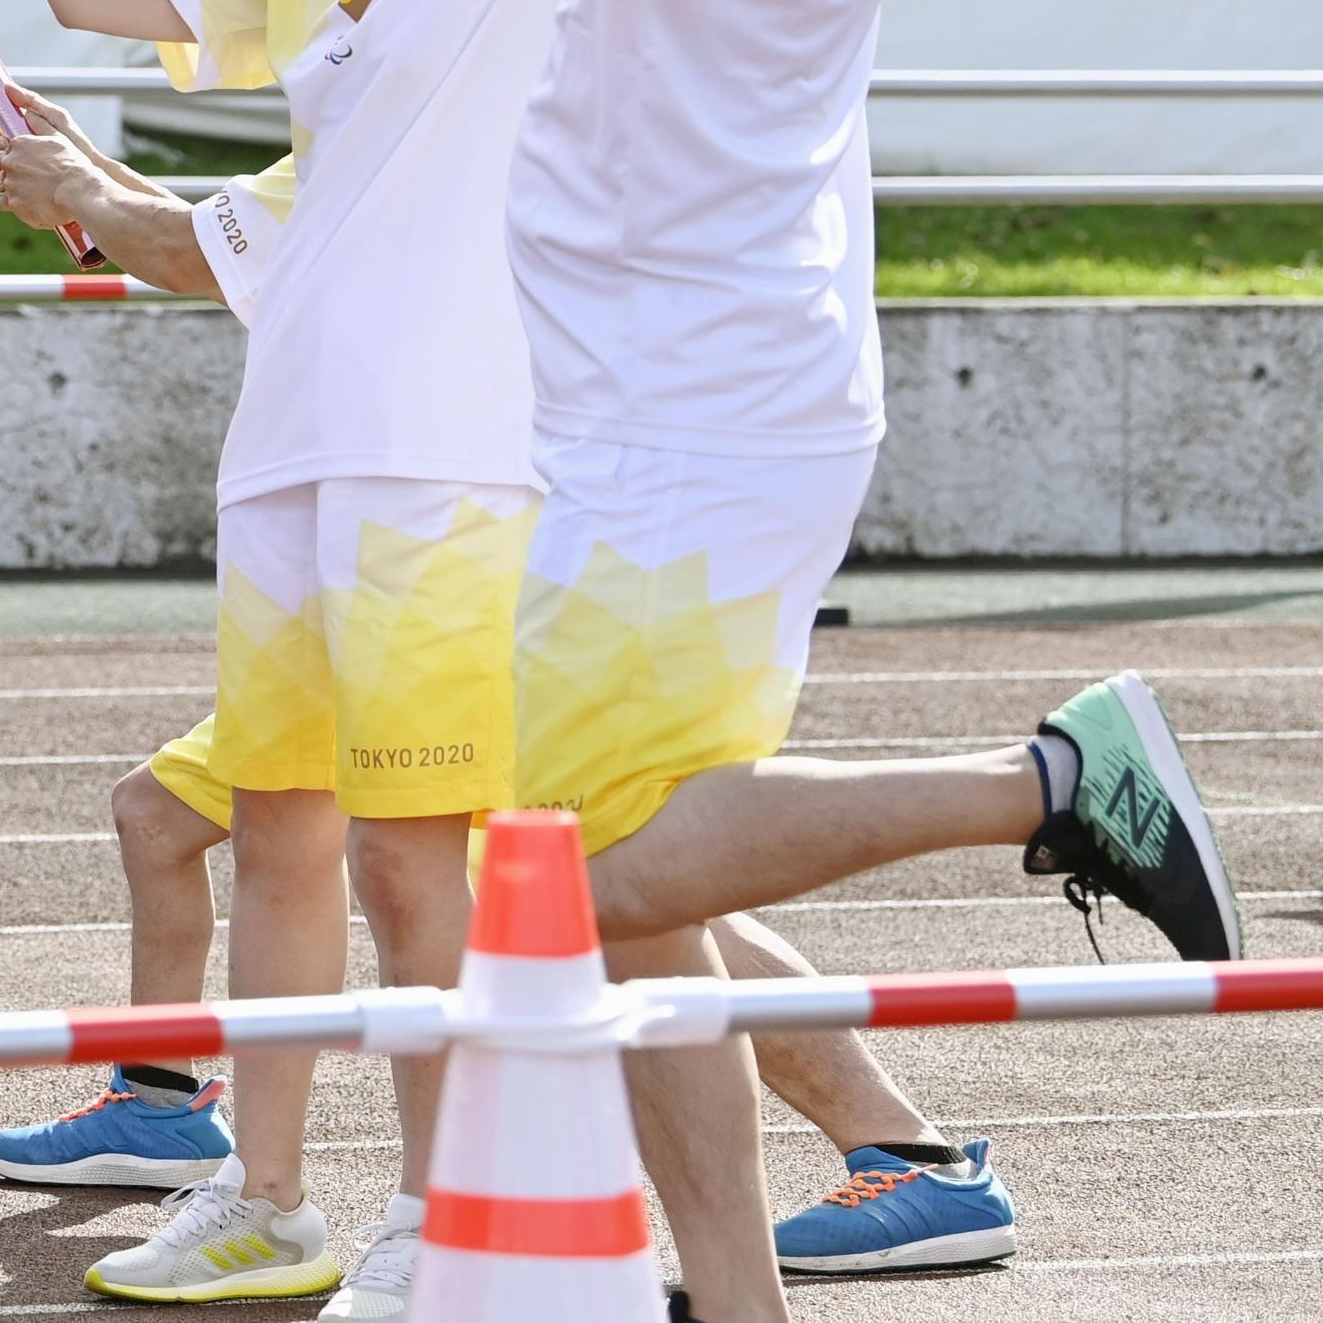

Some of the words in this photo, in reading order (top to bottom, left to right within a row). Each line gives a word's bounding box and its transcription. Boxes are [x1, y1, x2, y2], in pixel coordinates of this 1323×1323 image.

[217, 208, 248, 255] 2020
[349, 747, 413, 769] TOKYO
[418, 742, 475, 768] 2020
